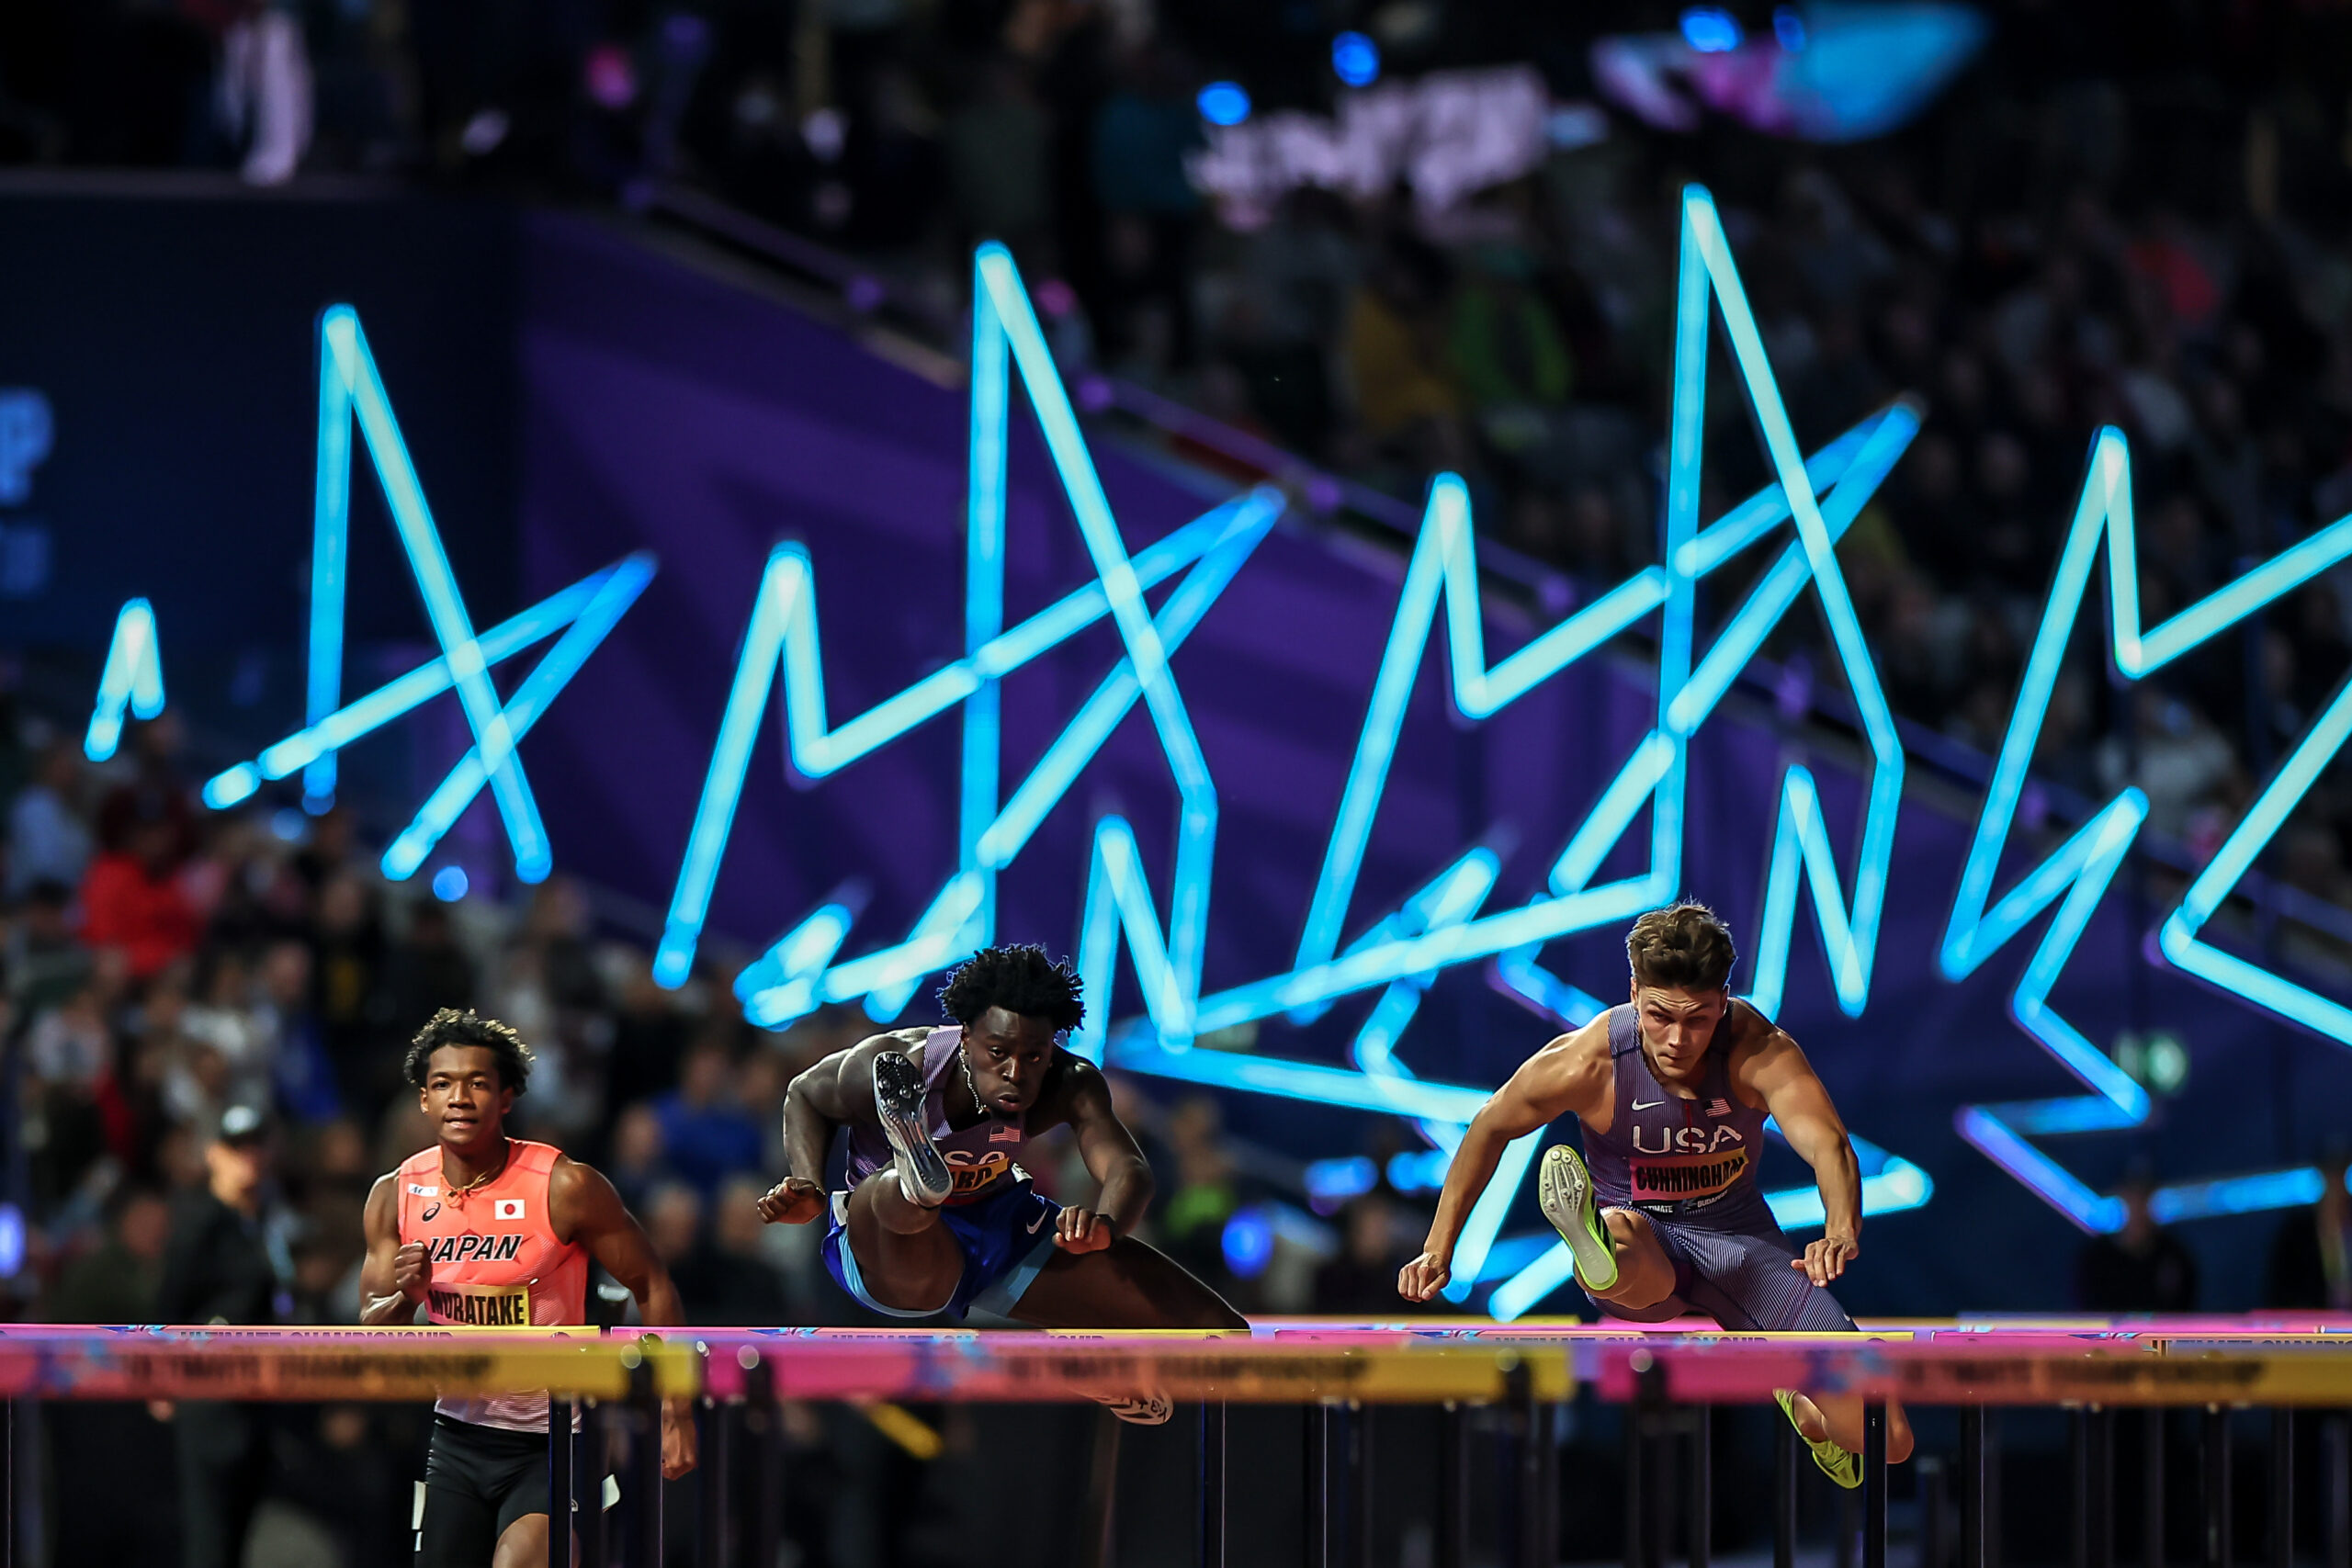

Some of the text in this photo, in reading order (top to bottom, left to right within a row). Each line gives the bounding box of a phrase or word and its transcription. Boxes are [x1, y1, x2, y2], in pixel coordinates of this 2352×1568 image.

[1633, 1125, 1743, 1154] USA
[1635, 1156, 1746, 1192] CUNNINGHAM
[427, 1234, 524, 1264] JAPAN
[427, 1288, 526, 1325] MURATAKE
